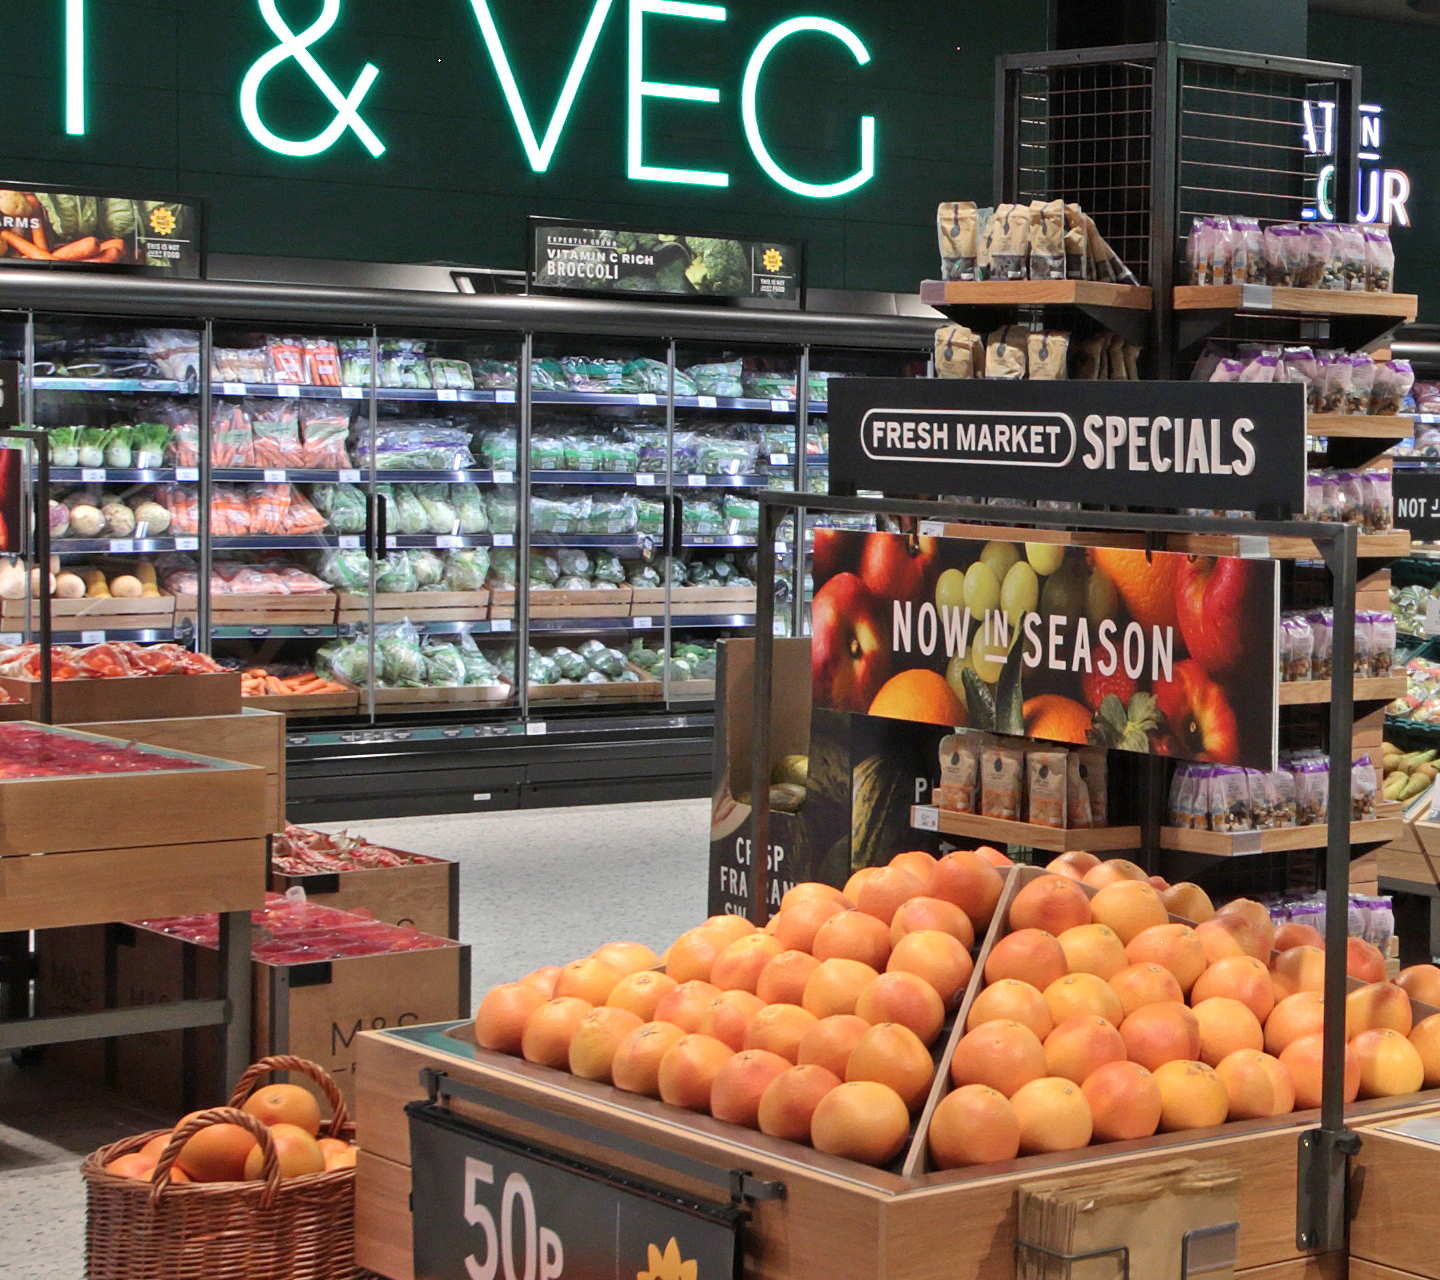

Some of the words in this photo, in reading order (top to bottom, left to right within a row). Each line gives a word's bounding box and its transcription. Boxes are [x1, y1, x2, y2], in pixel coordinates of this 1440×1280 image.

[547, 248, 606, 263] VITAMIN
[609, 250, 618, 263] C
[621, 253, 654, 266] RICH
[547, 260, 619, 280] BROCCOLI
[871, 420, 949, 451] FRESH
[956, 422, 1061, 455] MARKET
[1082, 413, 1256, 476] SPECIALS
[1398, 497, 1426, 518] NOT
[892, 599, 972, 659] NOW
[983, 608, 1009, 649] IN
[1022, 611, 1174, 684] SEASON
